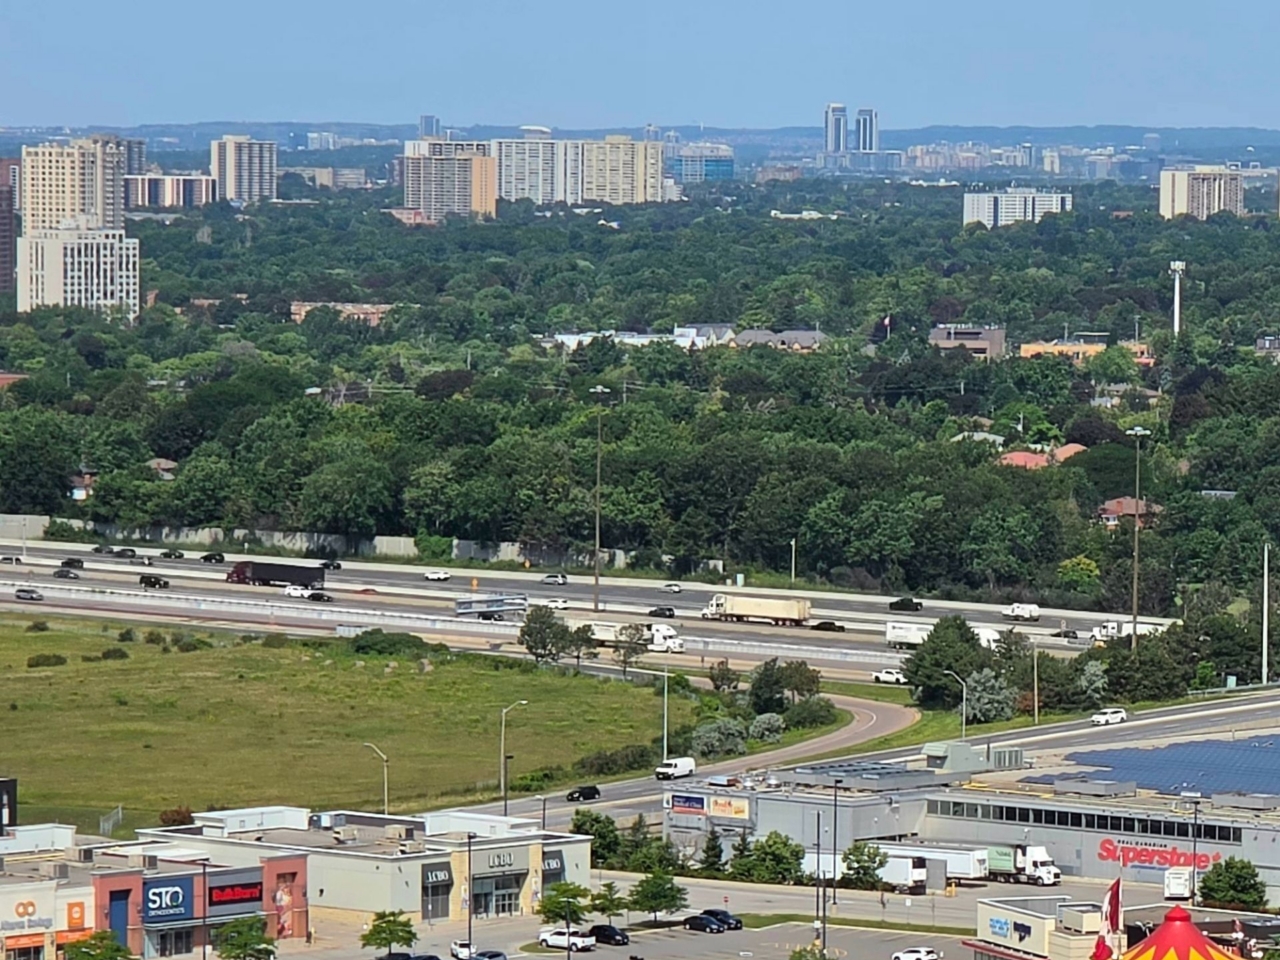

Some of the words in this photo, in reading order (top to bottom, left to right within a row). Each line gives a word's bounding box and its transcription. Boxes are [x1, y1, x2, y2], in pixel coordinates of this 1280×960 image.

[489, 852, 514, 868] LCBO
[1097, 838, 1210, 870] Superstore
[427, 870, 449, 882] LCBO
